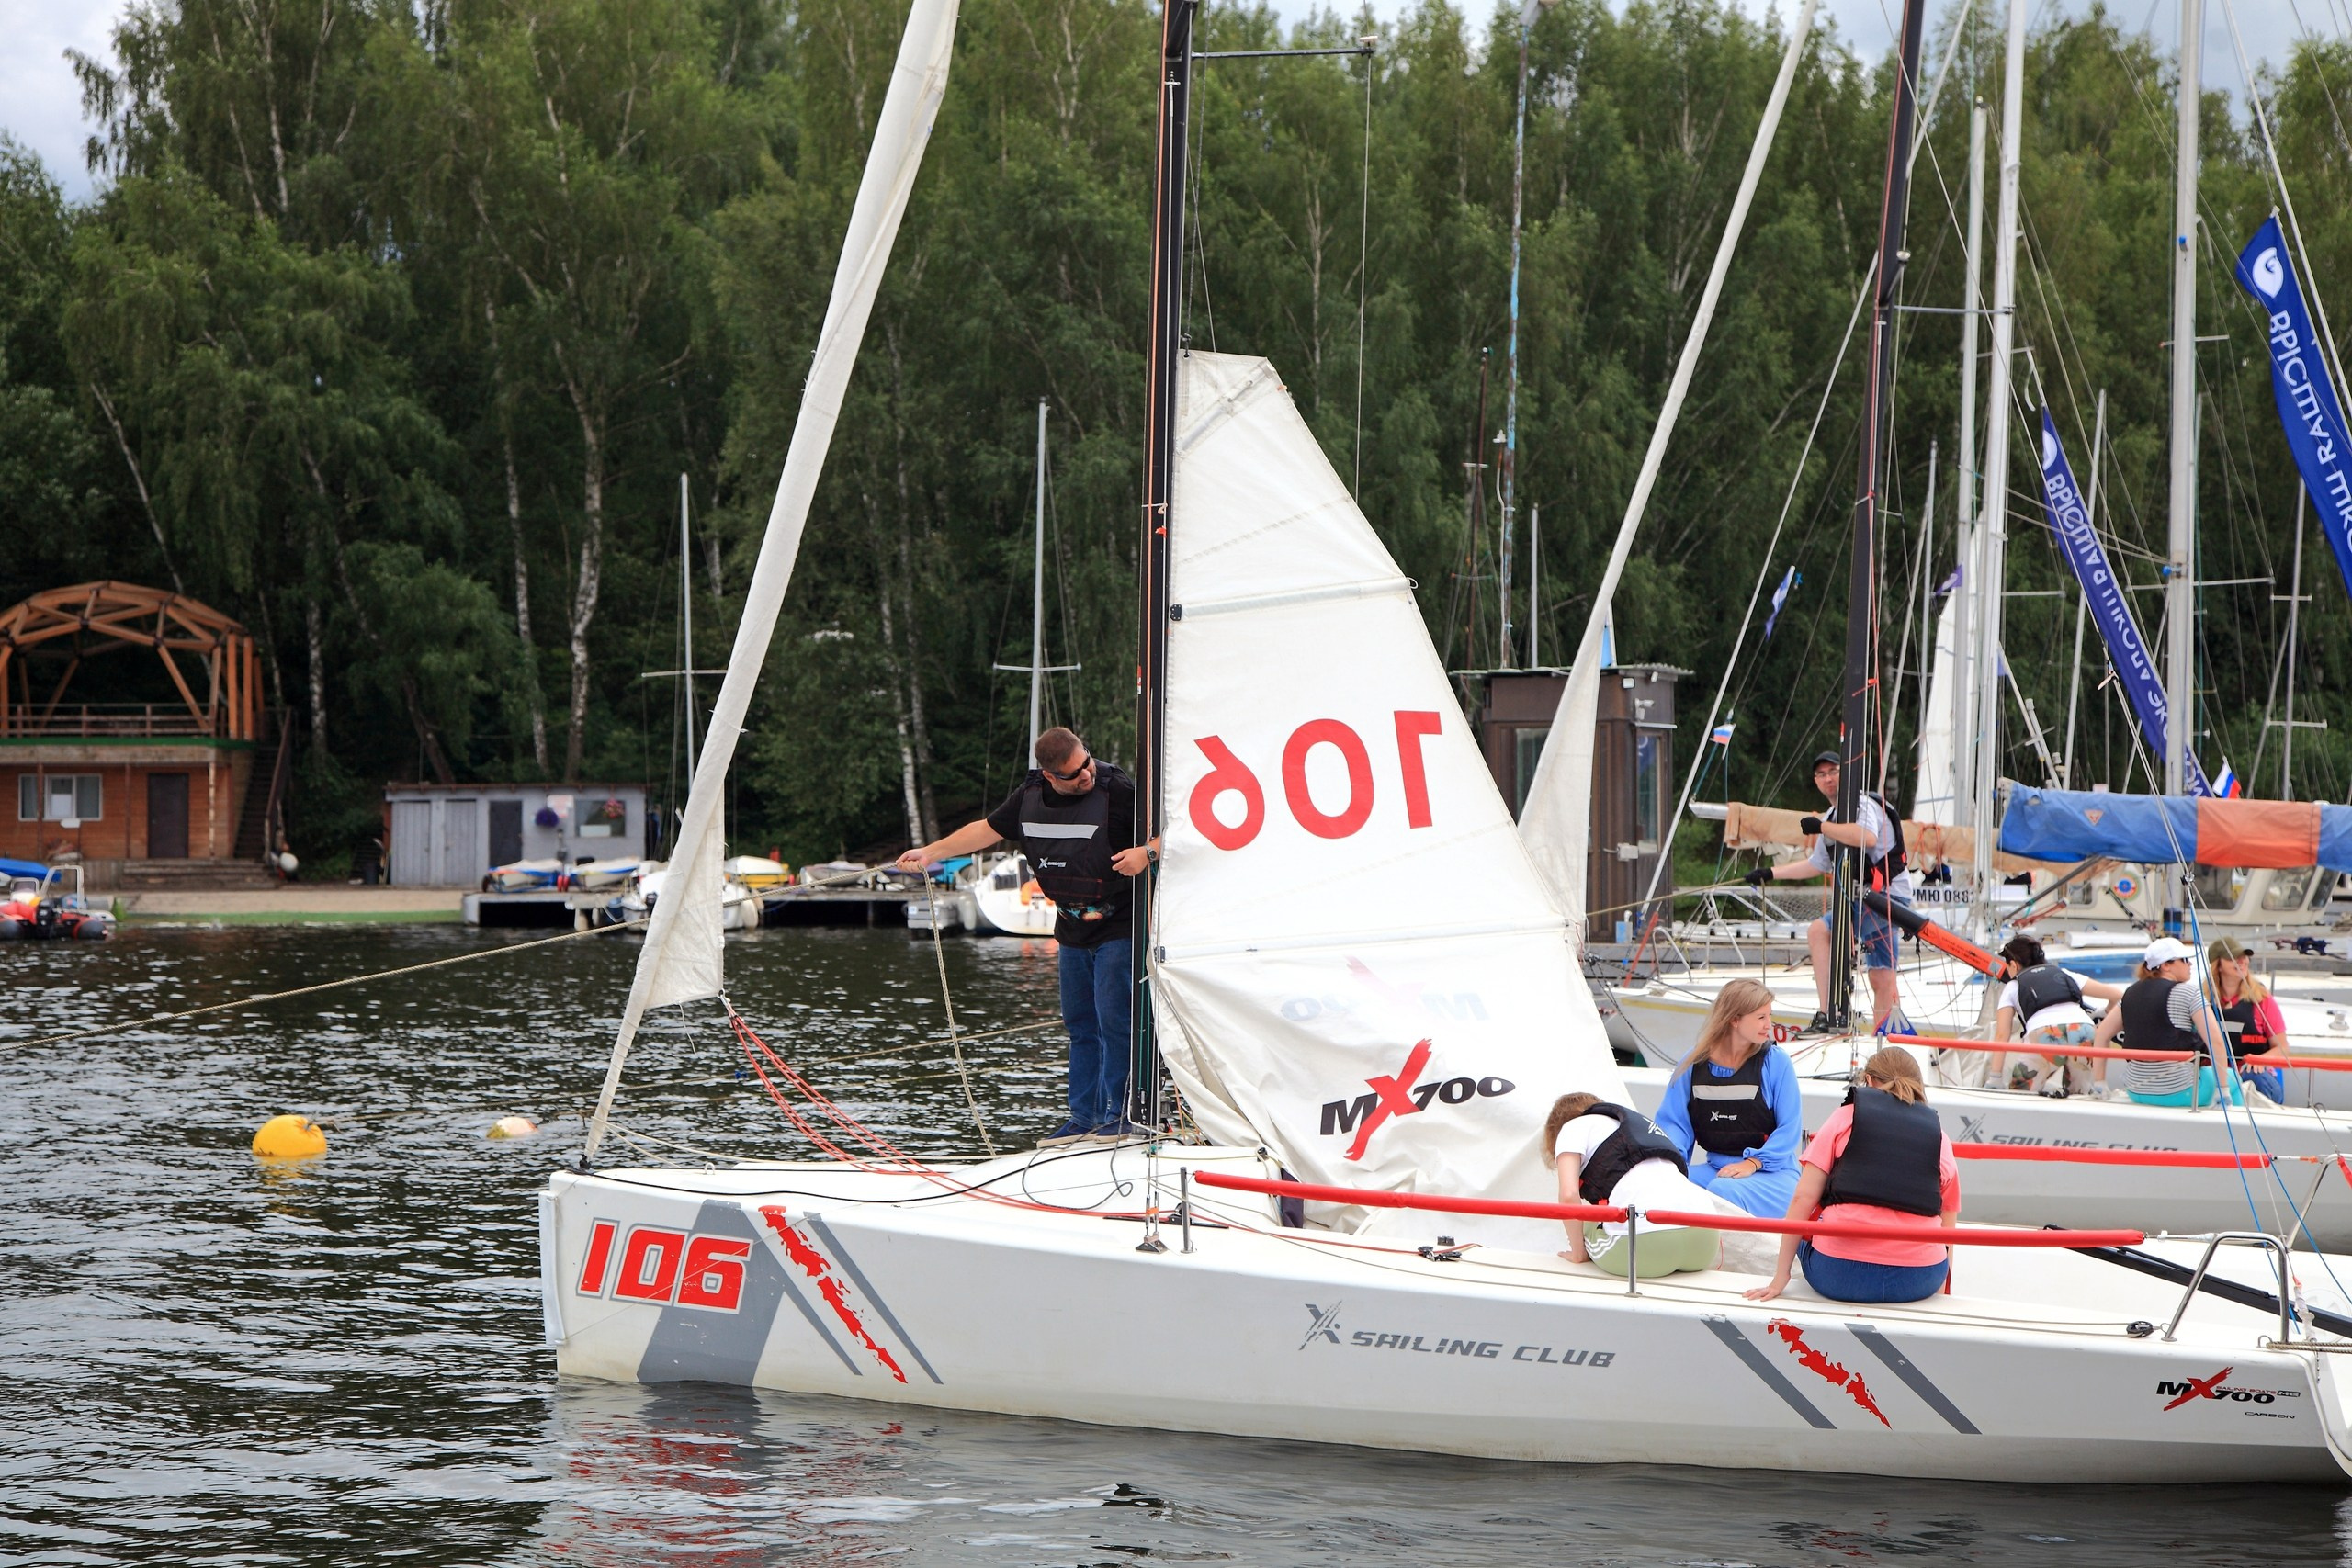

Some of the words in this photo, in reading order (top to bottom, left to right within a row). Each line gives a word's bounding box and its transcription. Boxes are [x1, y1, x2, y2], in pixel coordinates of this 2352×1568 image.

[1944, 889, 1973, 904] 088
[1320, 1038, 1516, 1161] MX700
[576, 1217, 754, 1314] 106
[1350, 1331, 1504, 1359] SAILING
[1512, 1346, 1616, 1368] CLUB
[2156, 1366, 2275, 1412] MX700
[2245, 1411, 2295, 1419] CARBON
